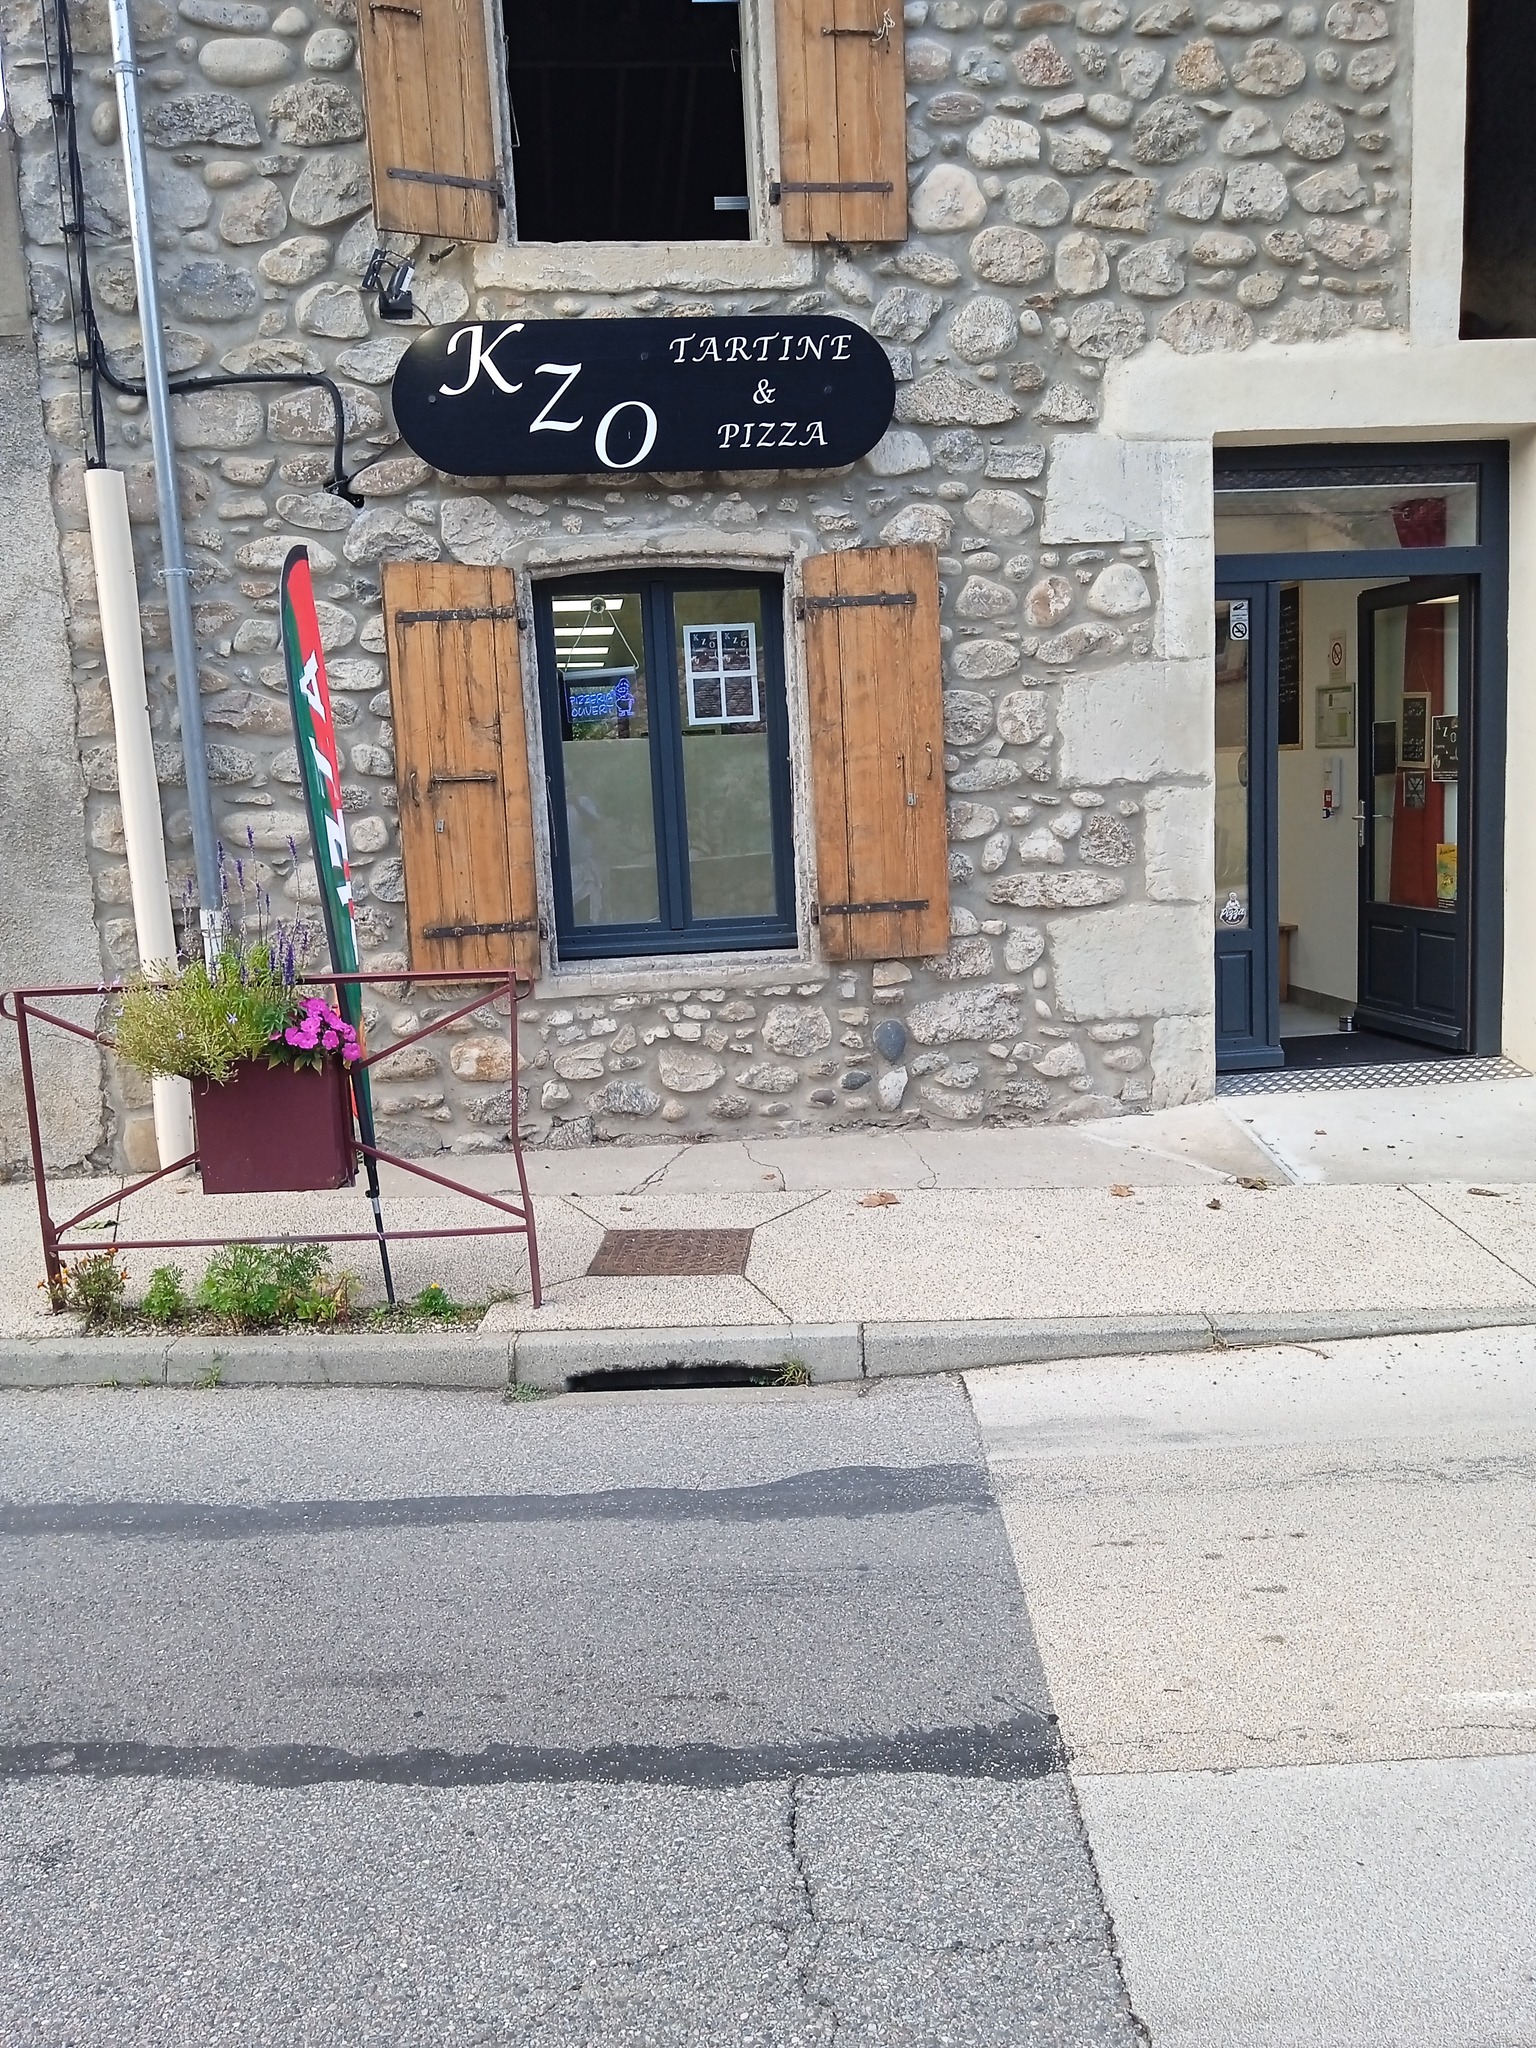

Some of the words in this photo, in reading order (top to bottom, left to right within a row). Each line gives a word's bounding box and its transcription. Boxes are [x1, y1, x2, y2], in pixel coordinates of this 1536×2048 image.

[669, 333, 853, 364] TARTINE
[753, 379, 777, 405] &
[717, 420, 829, 449] PIZZA
[571, 704, 614, 717] OUVERT
